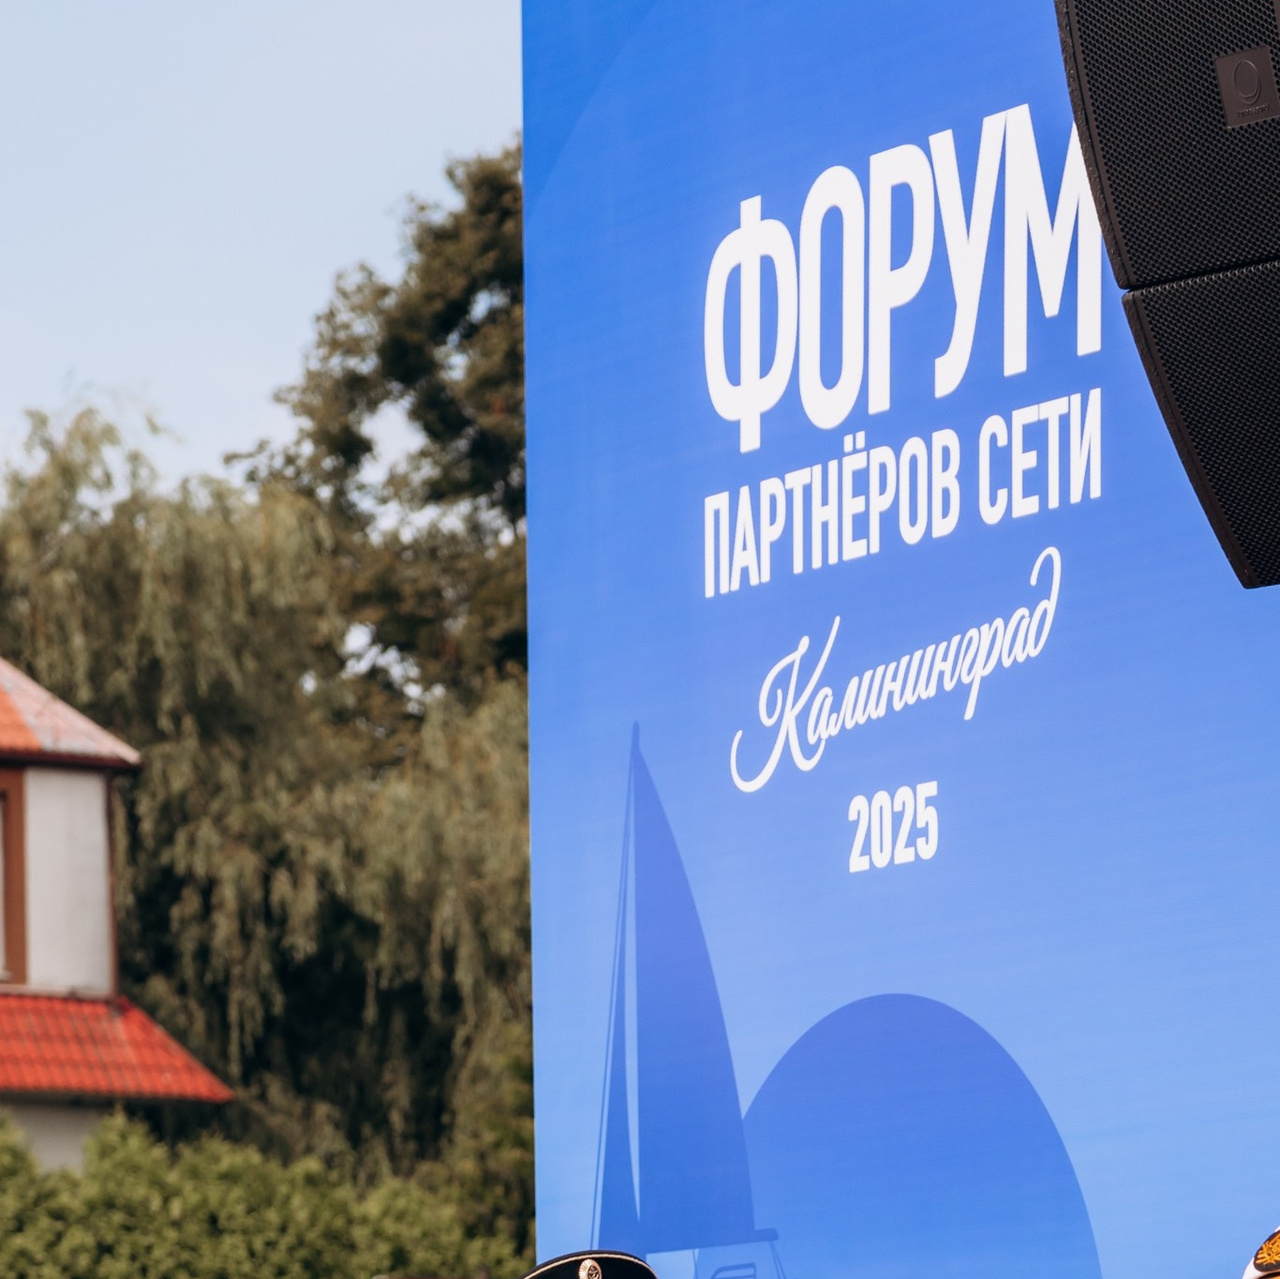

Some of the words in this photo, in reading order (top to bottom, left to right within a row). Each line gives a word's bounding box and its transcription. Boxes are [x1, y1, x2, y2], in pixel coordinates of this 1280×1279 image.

[703, 103, 1102, 454] ФОРУМ
[703, 428, 960, 599] ПАРТНЁРОВ
[978, 387, 1102, 525] СЕТИ
[730, 546, 1061, 793] Калининград
[848, 781, 938, 873] 2025
